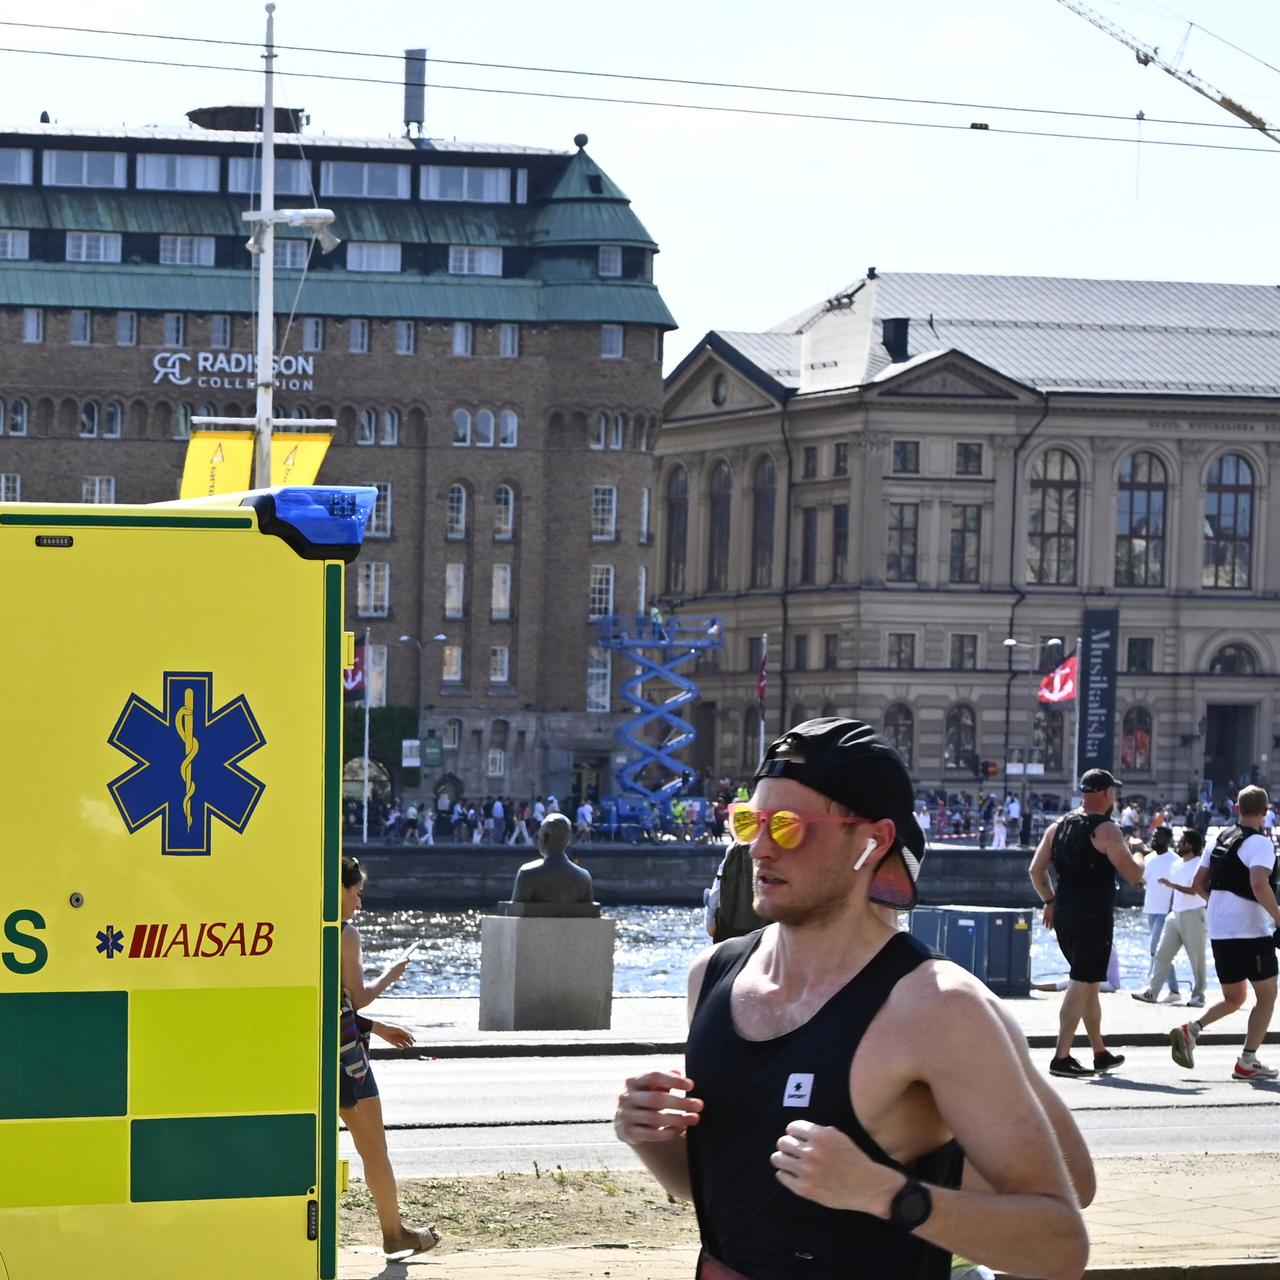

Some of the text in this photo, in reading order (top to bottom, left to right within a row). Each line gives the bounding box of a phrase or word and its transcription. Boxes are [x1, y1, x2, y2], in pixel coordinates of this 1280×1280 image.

[197, 352, 315, 376] RADISON
[197, 376, 315, 392] COLLEION
[1086, 628, 1112, 758] Musikaliska
